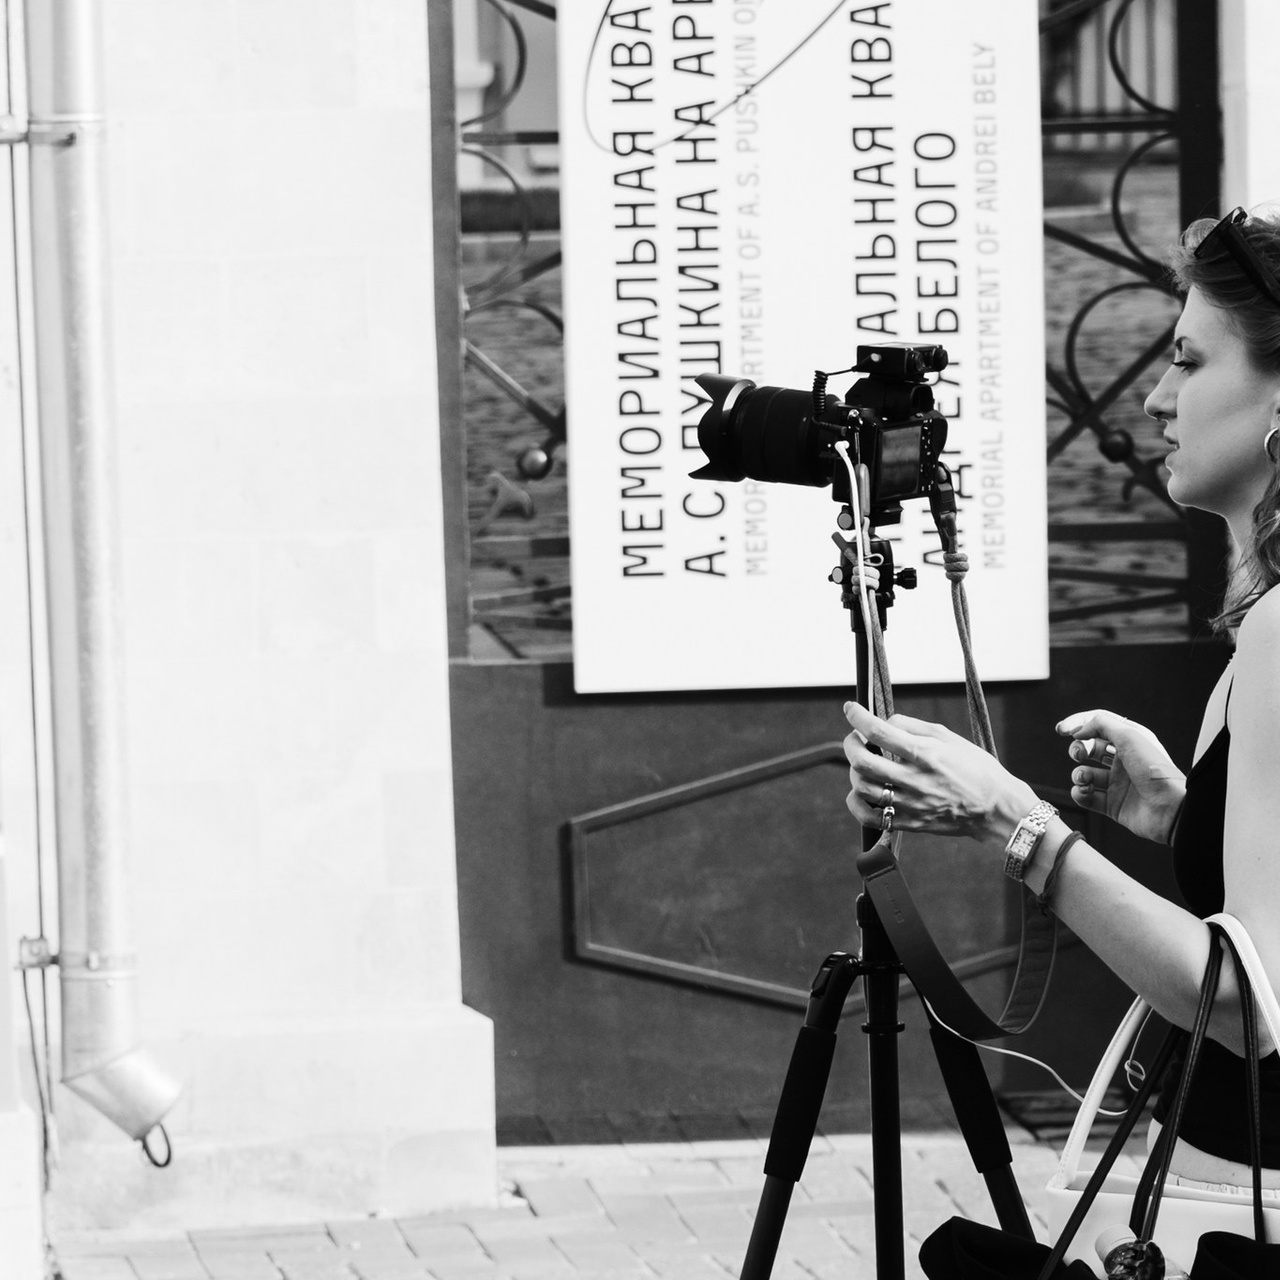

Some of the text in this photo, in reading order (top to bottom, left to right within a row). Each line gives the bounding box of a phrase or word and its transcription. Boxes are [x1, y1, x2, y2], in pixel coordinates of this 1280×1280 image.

[673, 101, 717, 164] НА
[734, 36, 760, 154] PUSHKIN
[737, 227, 762, 261] OF
[913, 132, 960, 335] БЕЛОГО
[971, 42, 1006, 570] MEMORIAL APARTMENT OF ANDREI BELY
[612, 130, 664, 578] МЕМОРИАЛЬНАЯ
